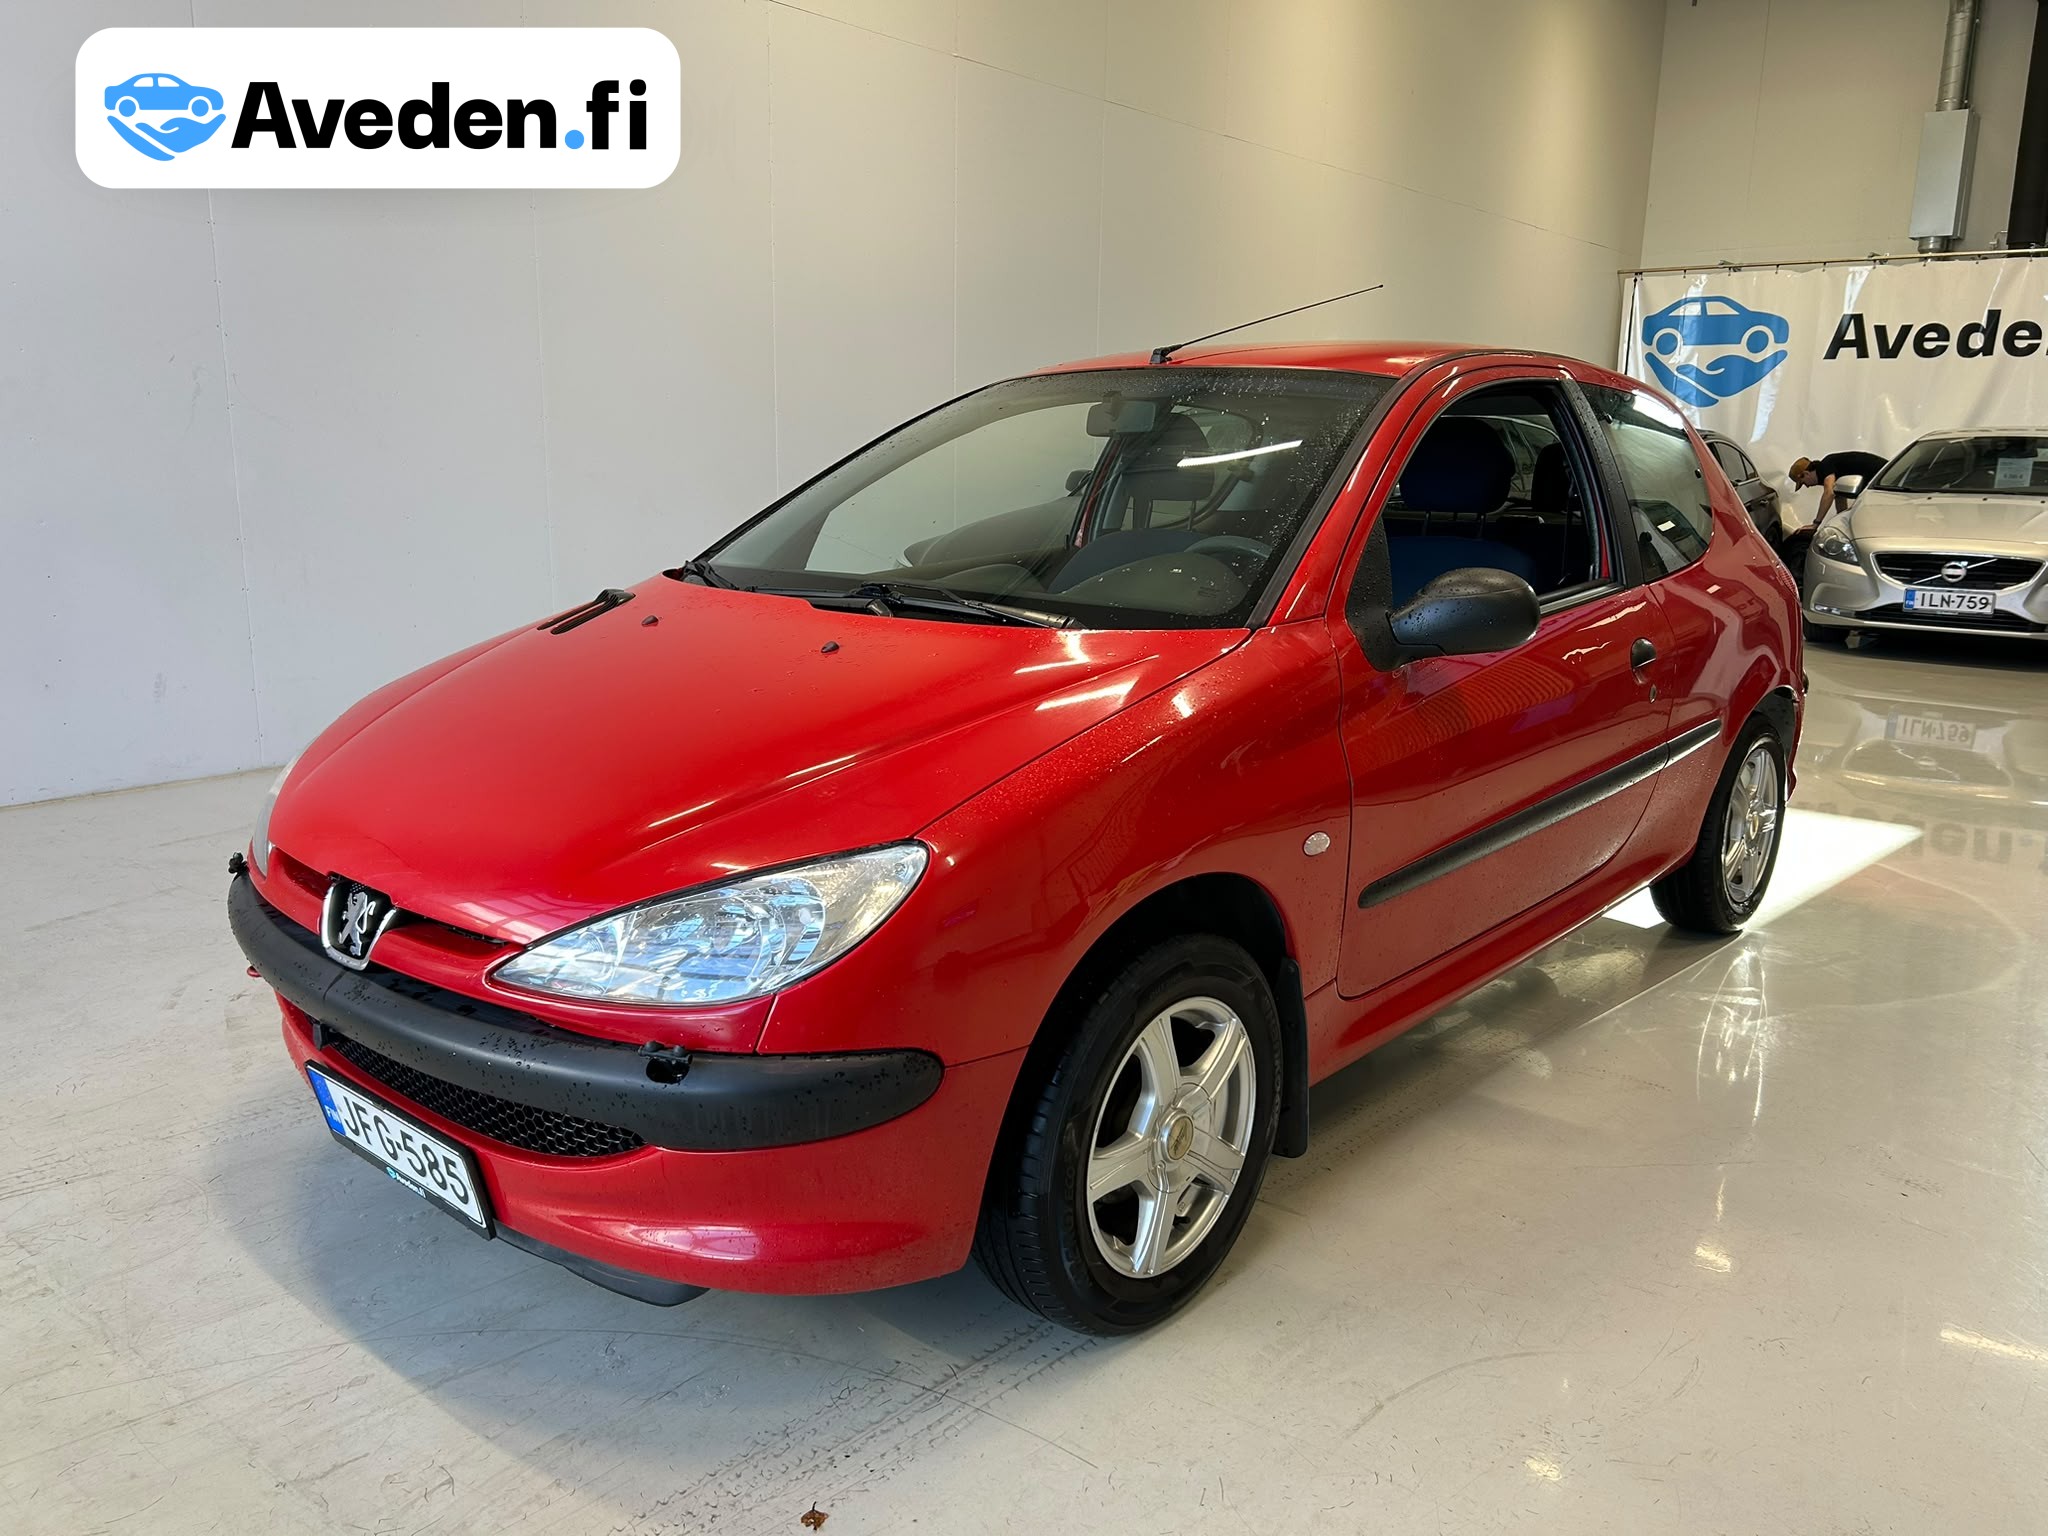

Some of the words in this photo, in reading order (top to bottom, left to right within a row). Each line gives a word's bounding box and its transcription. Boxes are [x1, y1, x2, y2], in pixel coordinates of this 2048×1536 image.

[1823, 309, 2048, 360] Avede
[1920, 592, 1990, 610] ILN-759
[343, 1095, 469, 1205] JFG-585
